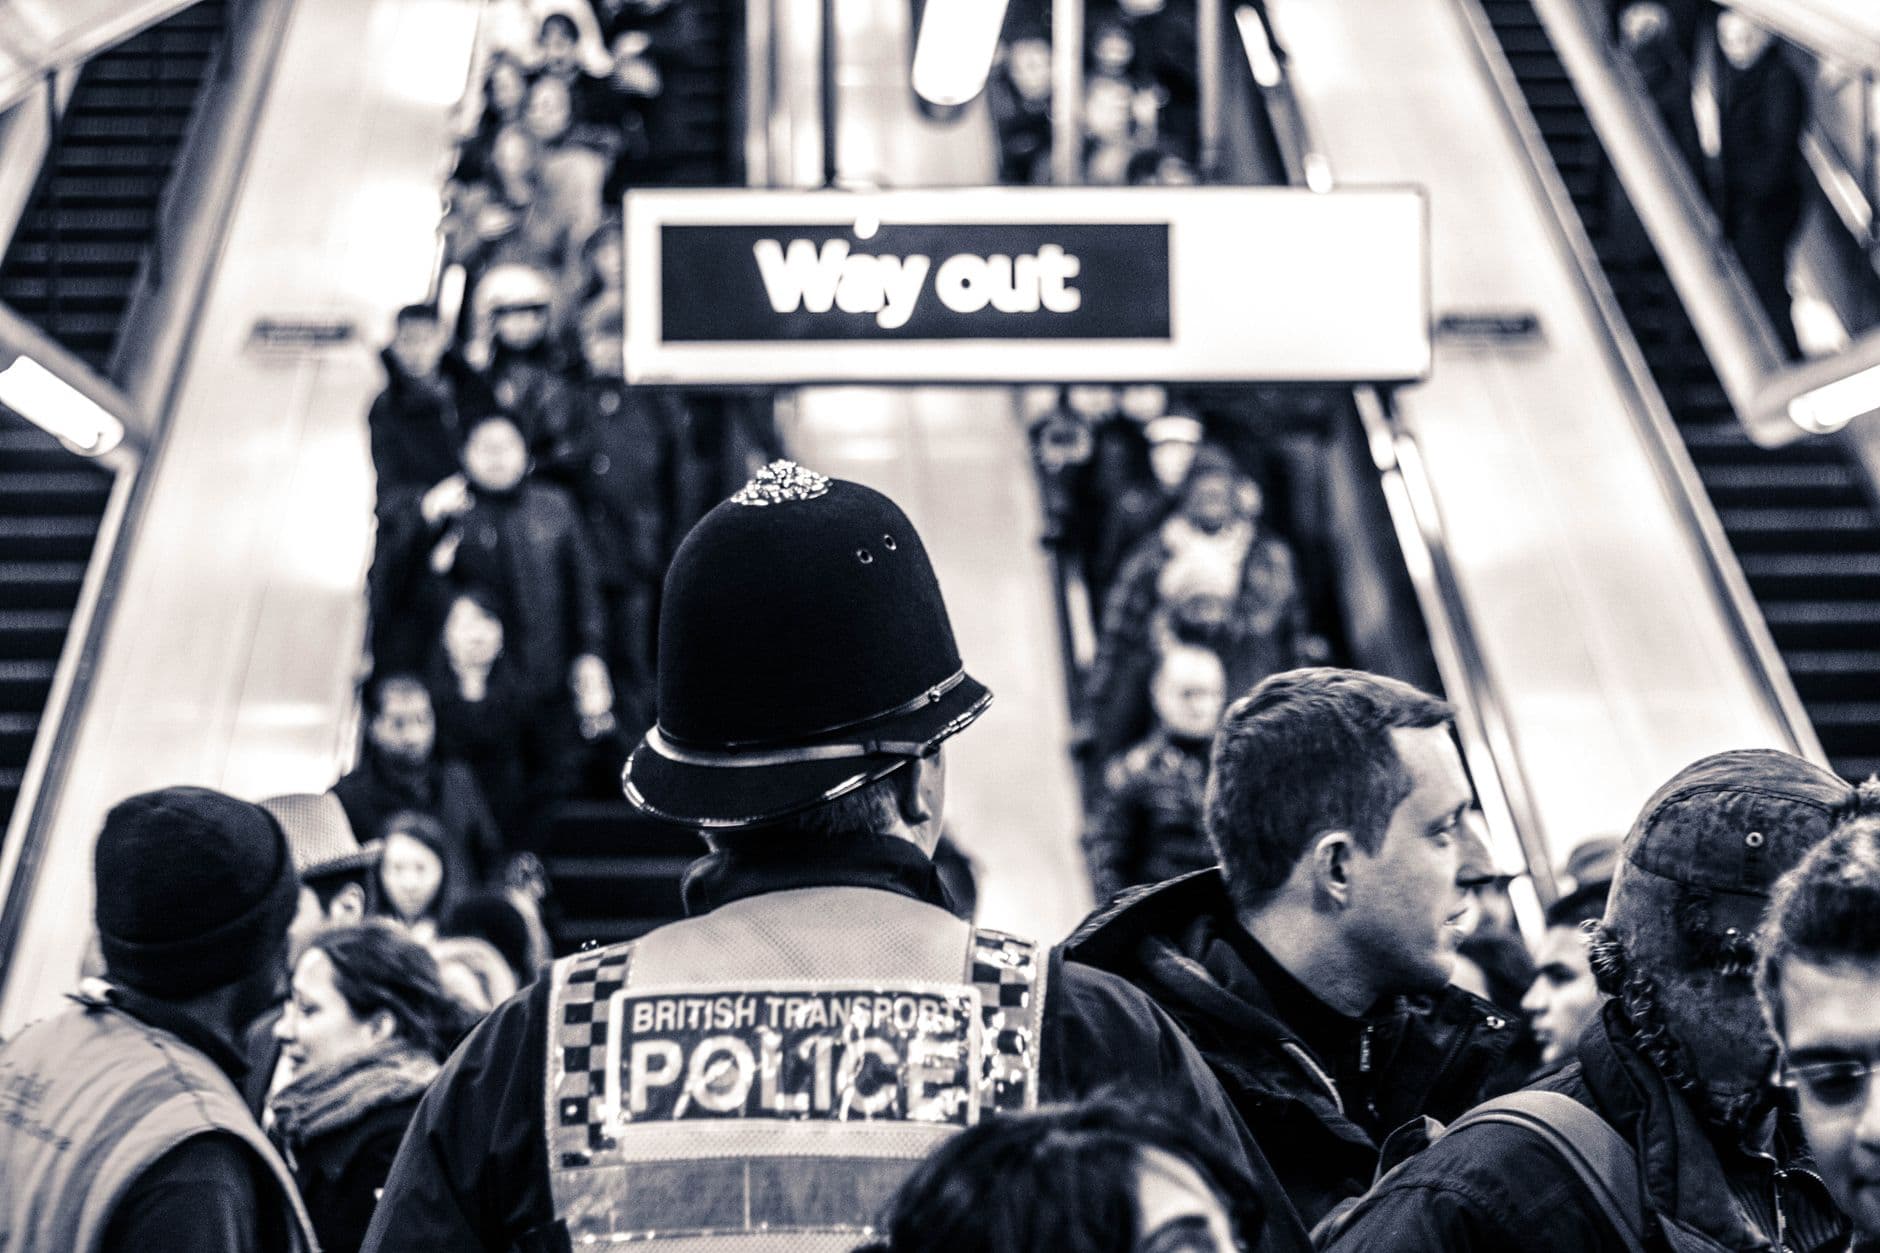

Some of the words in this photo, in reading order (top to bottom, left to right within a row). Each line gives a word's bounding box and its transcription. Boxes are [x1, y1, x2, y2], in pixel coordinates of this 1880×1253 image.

[752, 238, 931, 329] Way
[935, 243, 1081, 313] out
[632, 996, 756, 1033] BRITISH
[765, 996, 958, 1032] TRANSPORT
[631, 1035, 966, 1117] POLICE
